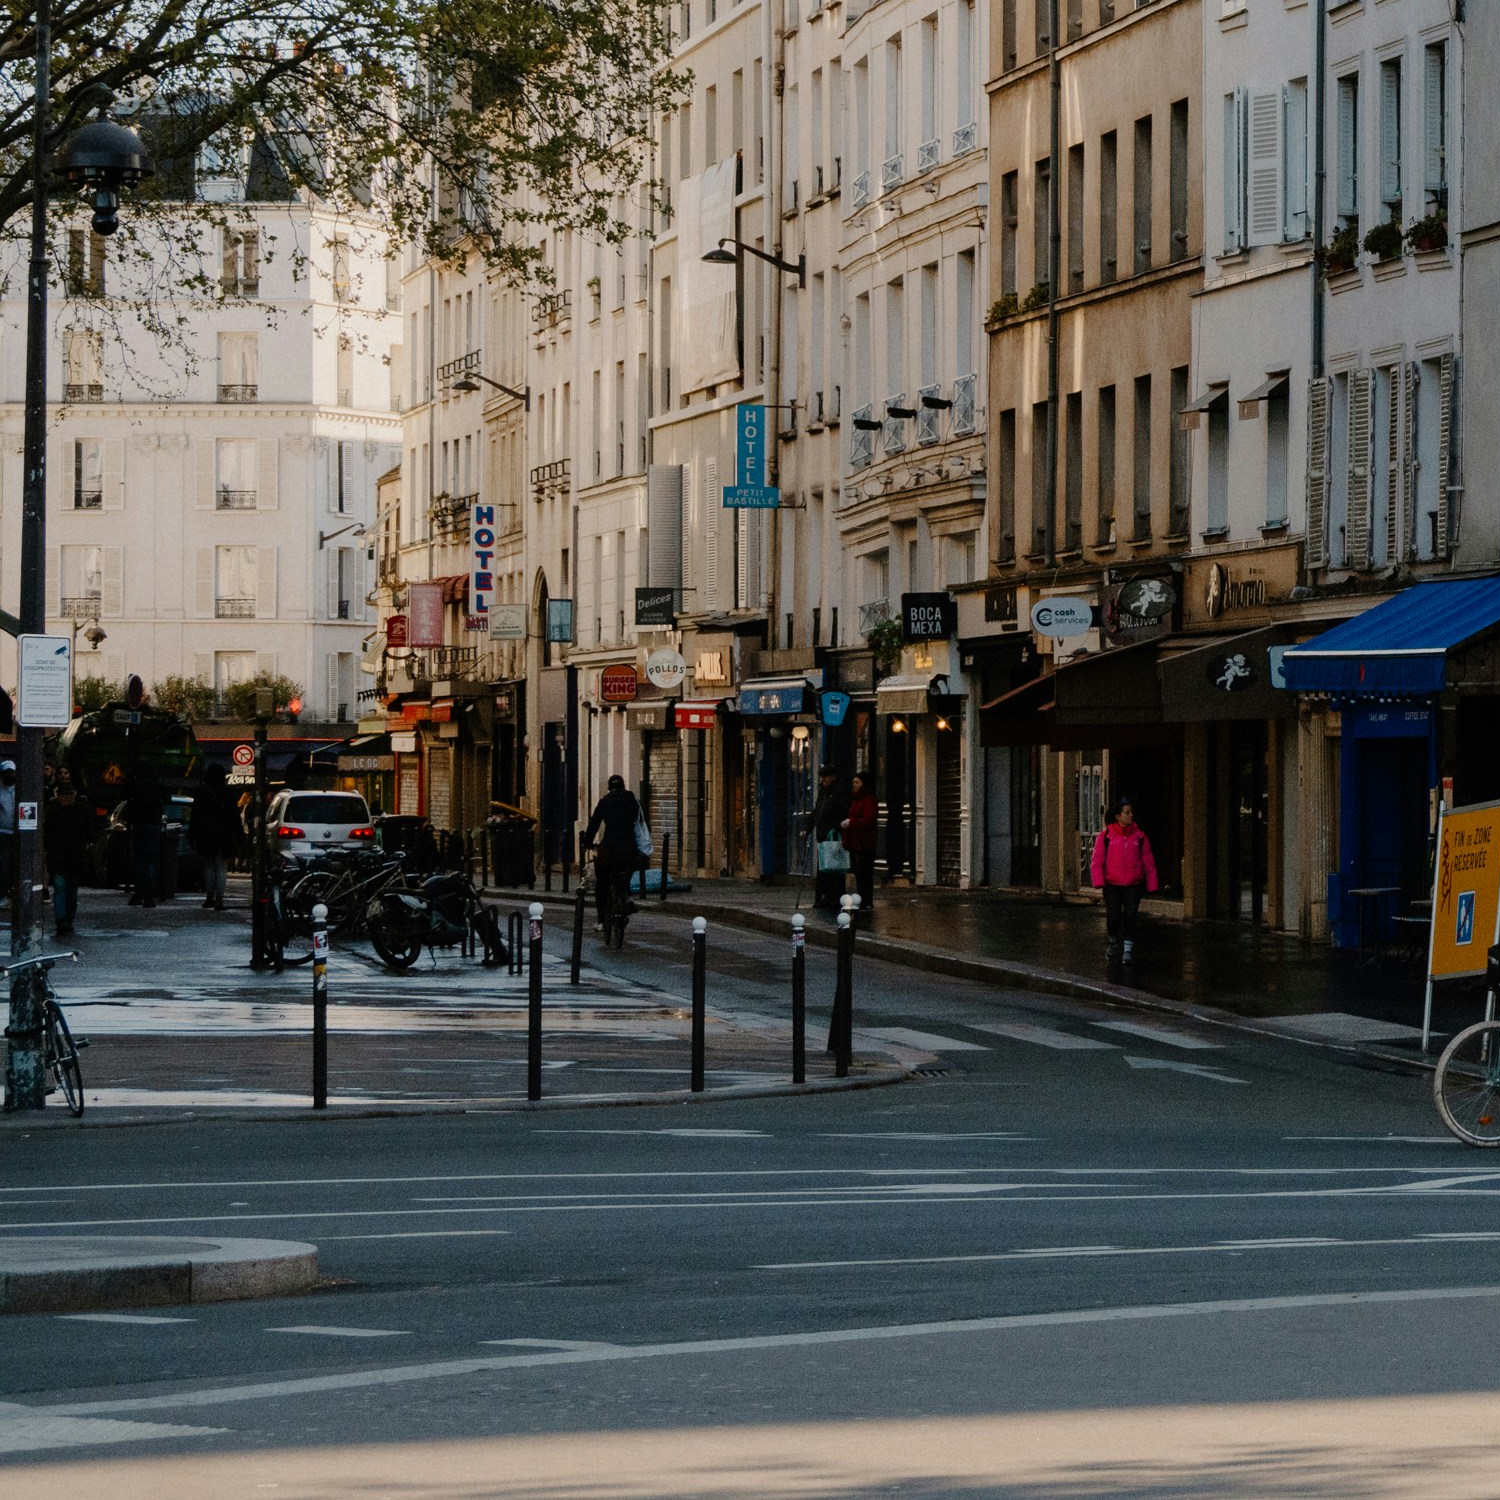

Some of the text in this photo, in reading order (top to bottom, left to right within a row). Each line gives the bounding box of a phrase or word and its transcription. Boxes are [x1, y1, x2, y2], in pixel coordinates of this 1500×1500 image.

[744, 410, 757, 485] HOTEL
[726, 496, 775, 506] BASTILLE
[474, 505, 495, 614] HOTEL
[910, 606, 942, 621] BOCA
[1054, 607, 1075, 617] cash
[1054, 616, 1089, 625] services
[910, 621, 942, 635] MEXA
[648, 665, 685, 676] POLLOS
[603, 676, 636, 684] BURGER
[603, 684, 636, 694] KING
[1453, 831, 1465, 848] FIN
[1473, 826, 1493, 846] ZONE
[1453, 850, 1488, 873] RÉSERVÉE
